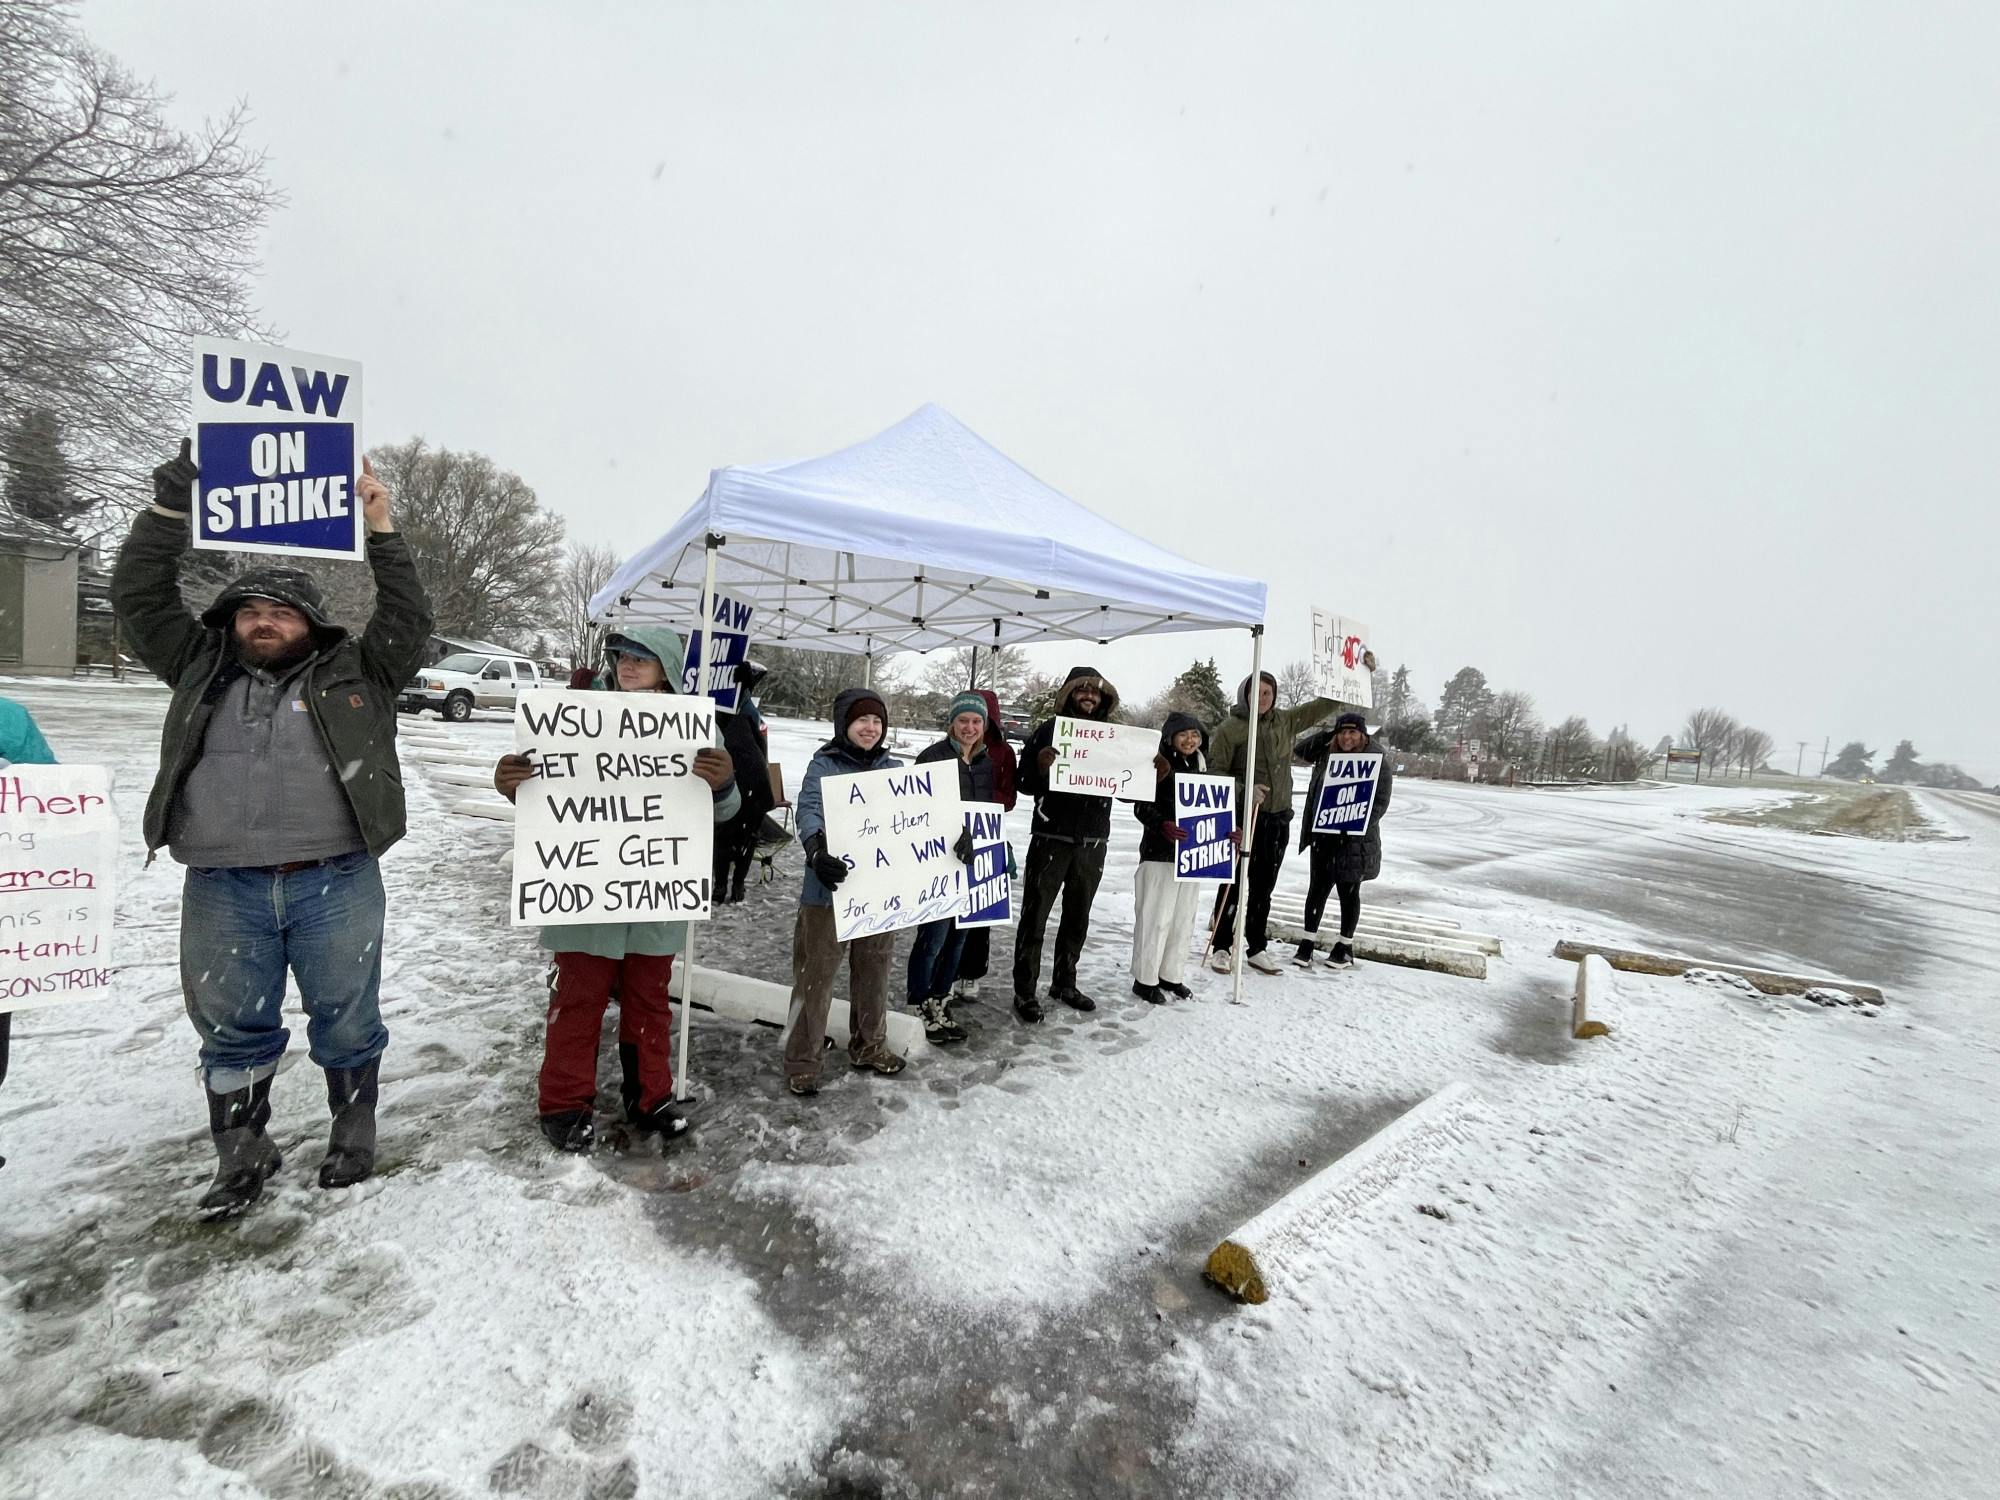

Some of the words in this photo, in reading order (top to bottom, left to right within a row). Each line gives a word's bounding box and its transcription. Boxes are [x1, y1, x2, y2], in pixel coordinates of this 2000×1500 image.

[202, 353, 350, 418] UAW
[251, 431, 305, 478] ON
[206, 475, 349, 533] STRIKE
[521, 702, 602, 739] WSU
[618, 707, 712, 741] ADMIN
[595, 752, 688, 782] RAISES
[1330, 760, 1376, 779] UAW
[849, 782, 866, 805] A
[888, 771, 933, 798] WIN
[1178, 782, 1231, 809] UAW
[1336, 785, 1357, 806] ON
[547, 794, 664, 824] WHILE
[858, 820, 880, 839] for
[890, 810, 930, 836] them
[1317, 800, 1369, 827] STRIKE
[1195, 817, 1216, 844] ON
[535, 838, 601, 870] WE
[618, 834, 689, 868] GET
[841, 854, 856, 870] S
[875, 847, 890, 868] A
[911, 836, 947, 864] WIN
[973, 850, 994, 882] ON
[1180, 838, 1231, 874] STRIKE
[68, 907, 88, 921] is
[519, 878, 594, 920] FOOD
[603, 877, 709, 913] STAMPS!
[843, 898, 869, 918] for
[884, 895, 901, 911] us
